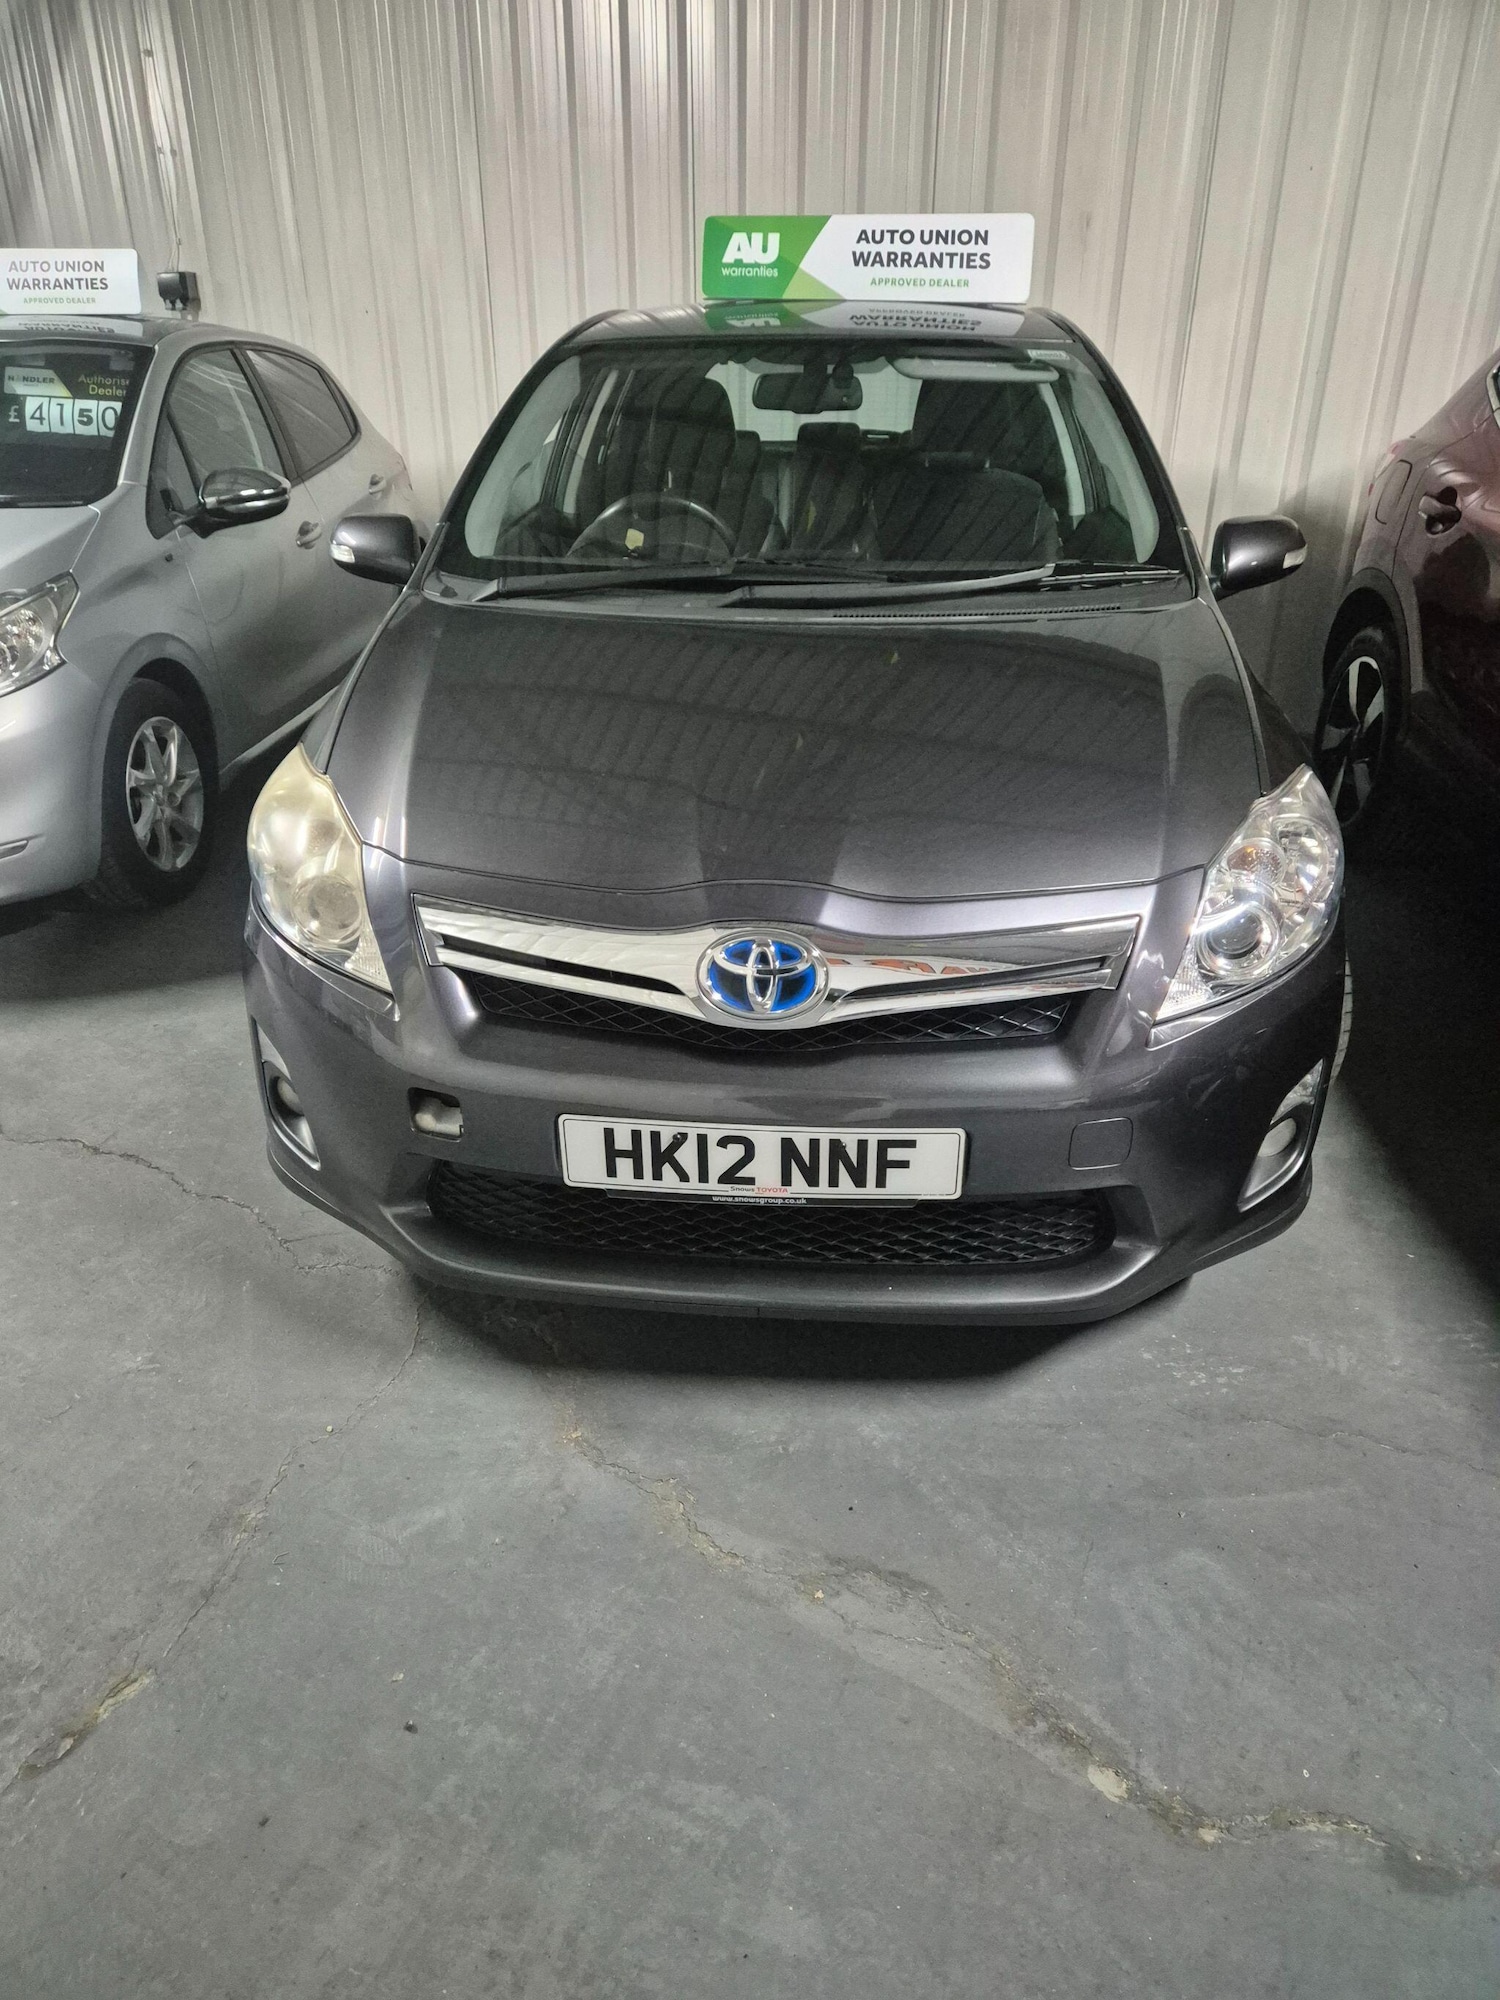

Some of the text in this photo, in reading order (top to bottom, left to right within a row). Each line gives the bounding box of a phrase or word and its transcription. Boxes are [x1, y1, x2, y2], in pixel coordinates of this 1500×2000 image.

[856, 229, 989, 245] AUTO UNION
[722, 232, 780, 264] AU
[852, 250, 991, 270] WARRANTIES
[8, 261, 105, 273] AUTO UNION
[721, 266, 778, 277] warranties
[7, 277, 109, 290] WARRANTIES
[870, 277, 970, 288] APPROVED DEALER
[23, 297, 96, 305] APPROVED DEALER
[8, 375, 55, 384] HNDLER
[603, 1127, 917, 1189] HK12 NNF
[712, 1195, 807, 1205] www.snowsgroup.co.uk
